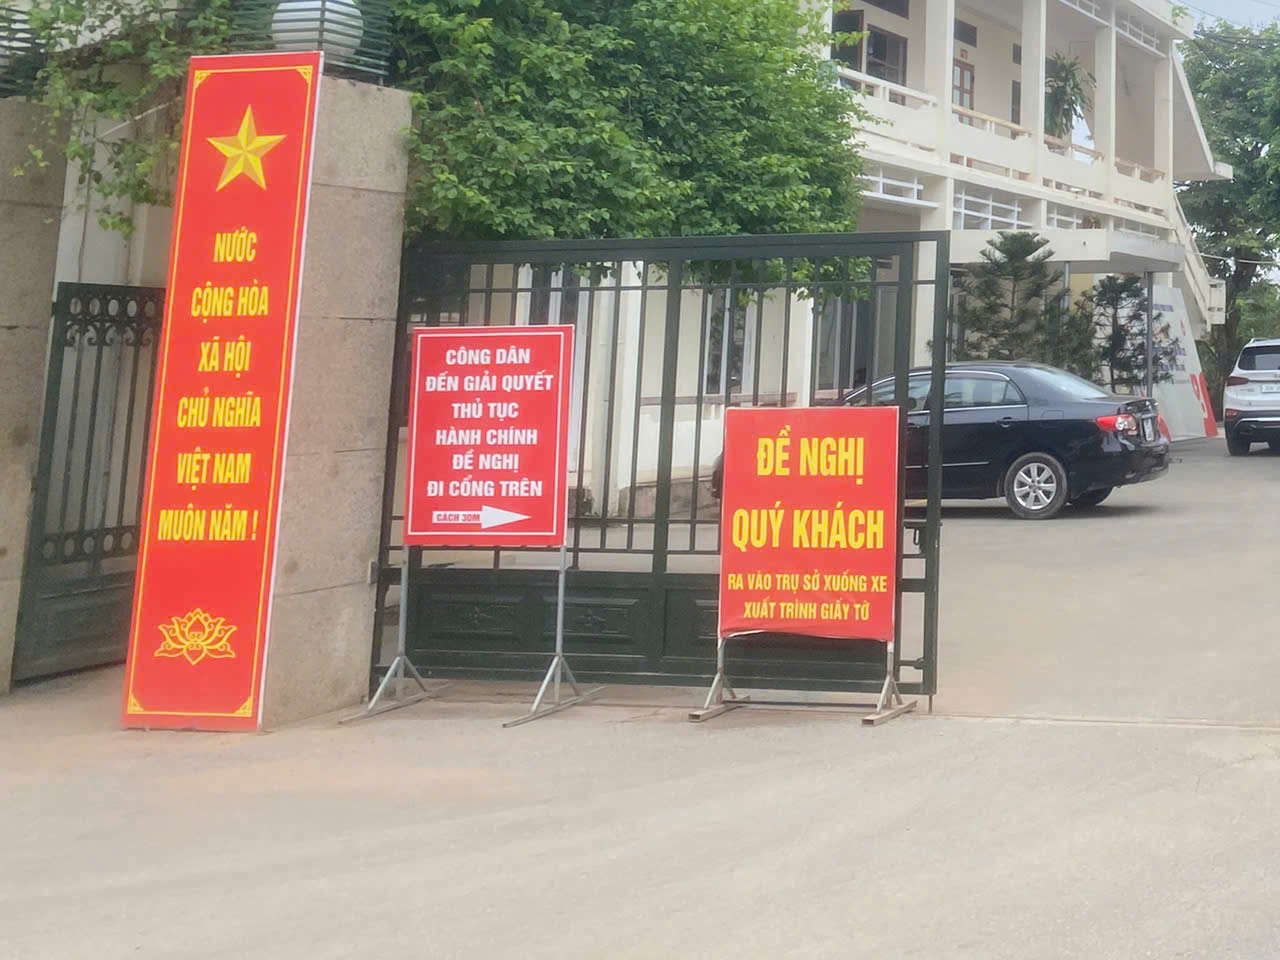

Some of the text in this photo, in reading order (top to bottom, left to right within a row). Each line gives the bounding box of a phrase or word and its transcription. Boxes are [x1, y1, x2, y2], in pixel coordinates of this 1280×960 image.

[213, 226, 257, 262] NƯỚC
[191, 279, 269, 324] CỘNG HÒA
[198, 335, 251, 378] XÃ HỘI
[446, 345, 531, 365] CÔNG DÂN
[425, 369, 554, 392] ĐẾN GIẢI QUYẾT
[177, 386, 262, 428] CHỦ NGHĨA
[451, 397, 519, 422] THỦ TỤC
[435, 425, 538, 445] HÀNH CHÍNH
[177, 446, 252, 491] VIỆT NAM
[478, 453, 520, 473] NGHỊ
[757, 425, 865, 485] ĐỀ NGHỊ
[427, 474, 543, 497] ĐI CỔNG TRÊN
[158, 503, 206, 541] MUÔN
[732, 501, 884, 552] QUÝ KHÁCH
[728, 569, 888, 594] RA VÀO TRỤ SỞ XUỐNG XE
[743, 596, 871, 621] XUẤT TRÌNH GIẤY TỜ
